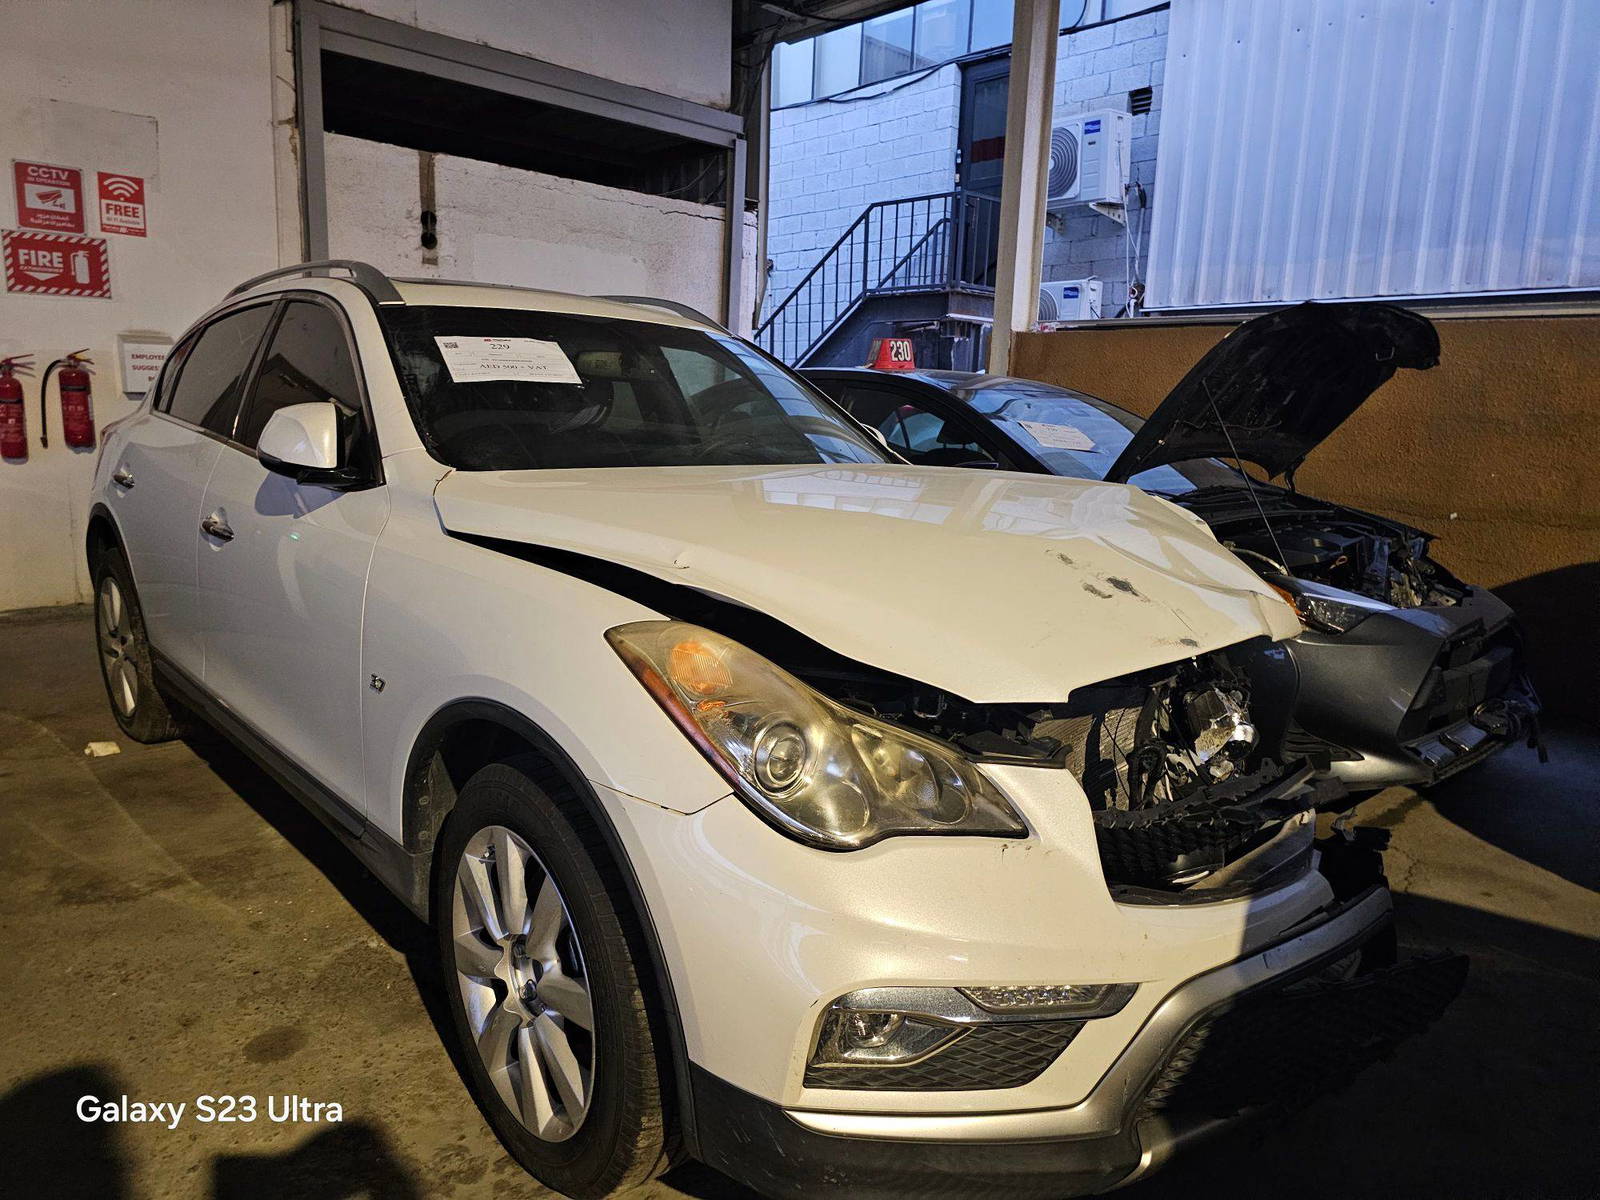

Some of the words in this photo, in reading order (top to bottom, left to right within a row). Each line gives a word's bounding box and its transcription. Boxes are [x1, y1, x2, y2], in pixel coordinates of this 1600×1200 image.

[28, 166, 69, 180] CCTV
[106, 203, 140, 218] FREE
[18, 249, 64, 267] FIRE
[890, 341, 911, 361] 230
